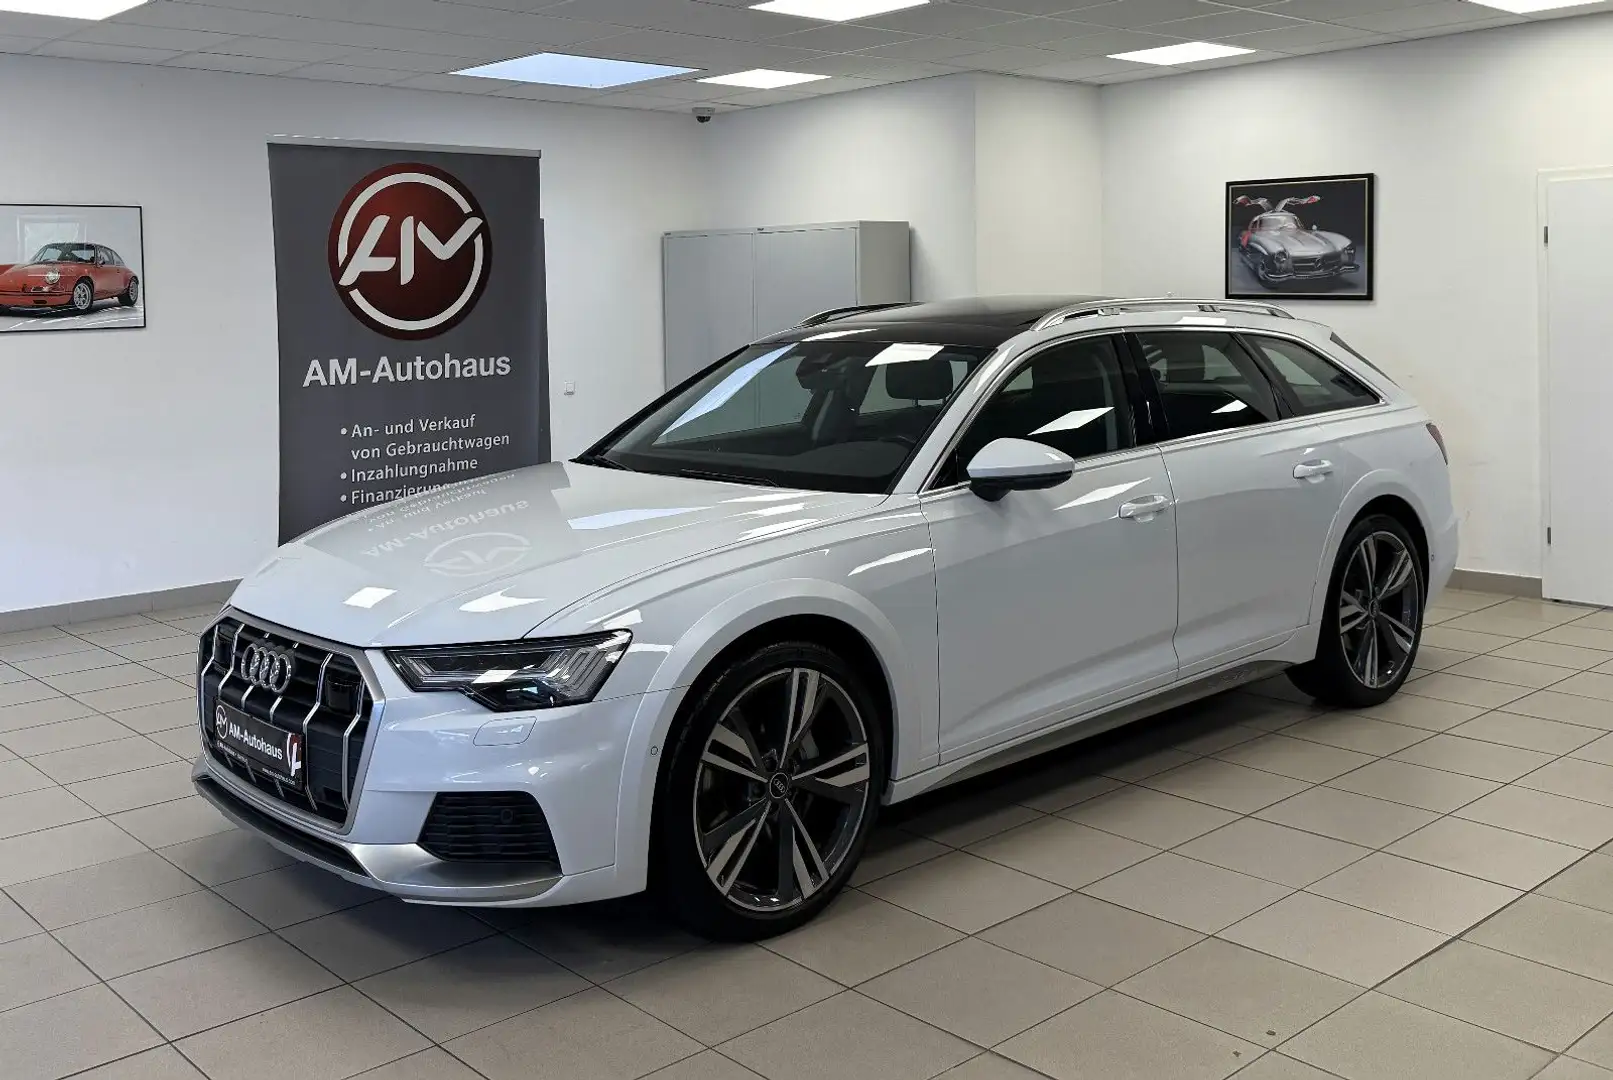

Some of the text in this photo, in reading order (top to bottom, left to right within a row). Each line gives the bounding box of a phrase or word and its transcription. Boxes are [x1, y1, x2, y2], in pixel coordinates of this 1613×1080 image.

[302, 353, 512, 388] AM-Autohaus
[351, 414, 476, 438] An- und Verkauf
[351, 434, 510, 460] von Gebrauchtwagen
[351, 458, 478, 483] Inzahlungnahme
[351, 483, 451, 505] Finanzierun
[229, 721, 283, 760] AM-Autohaus
